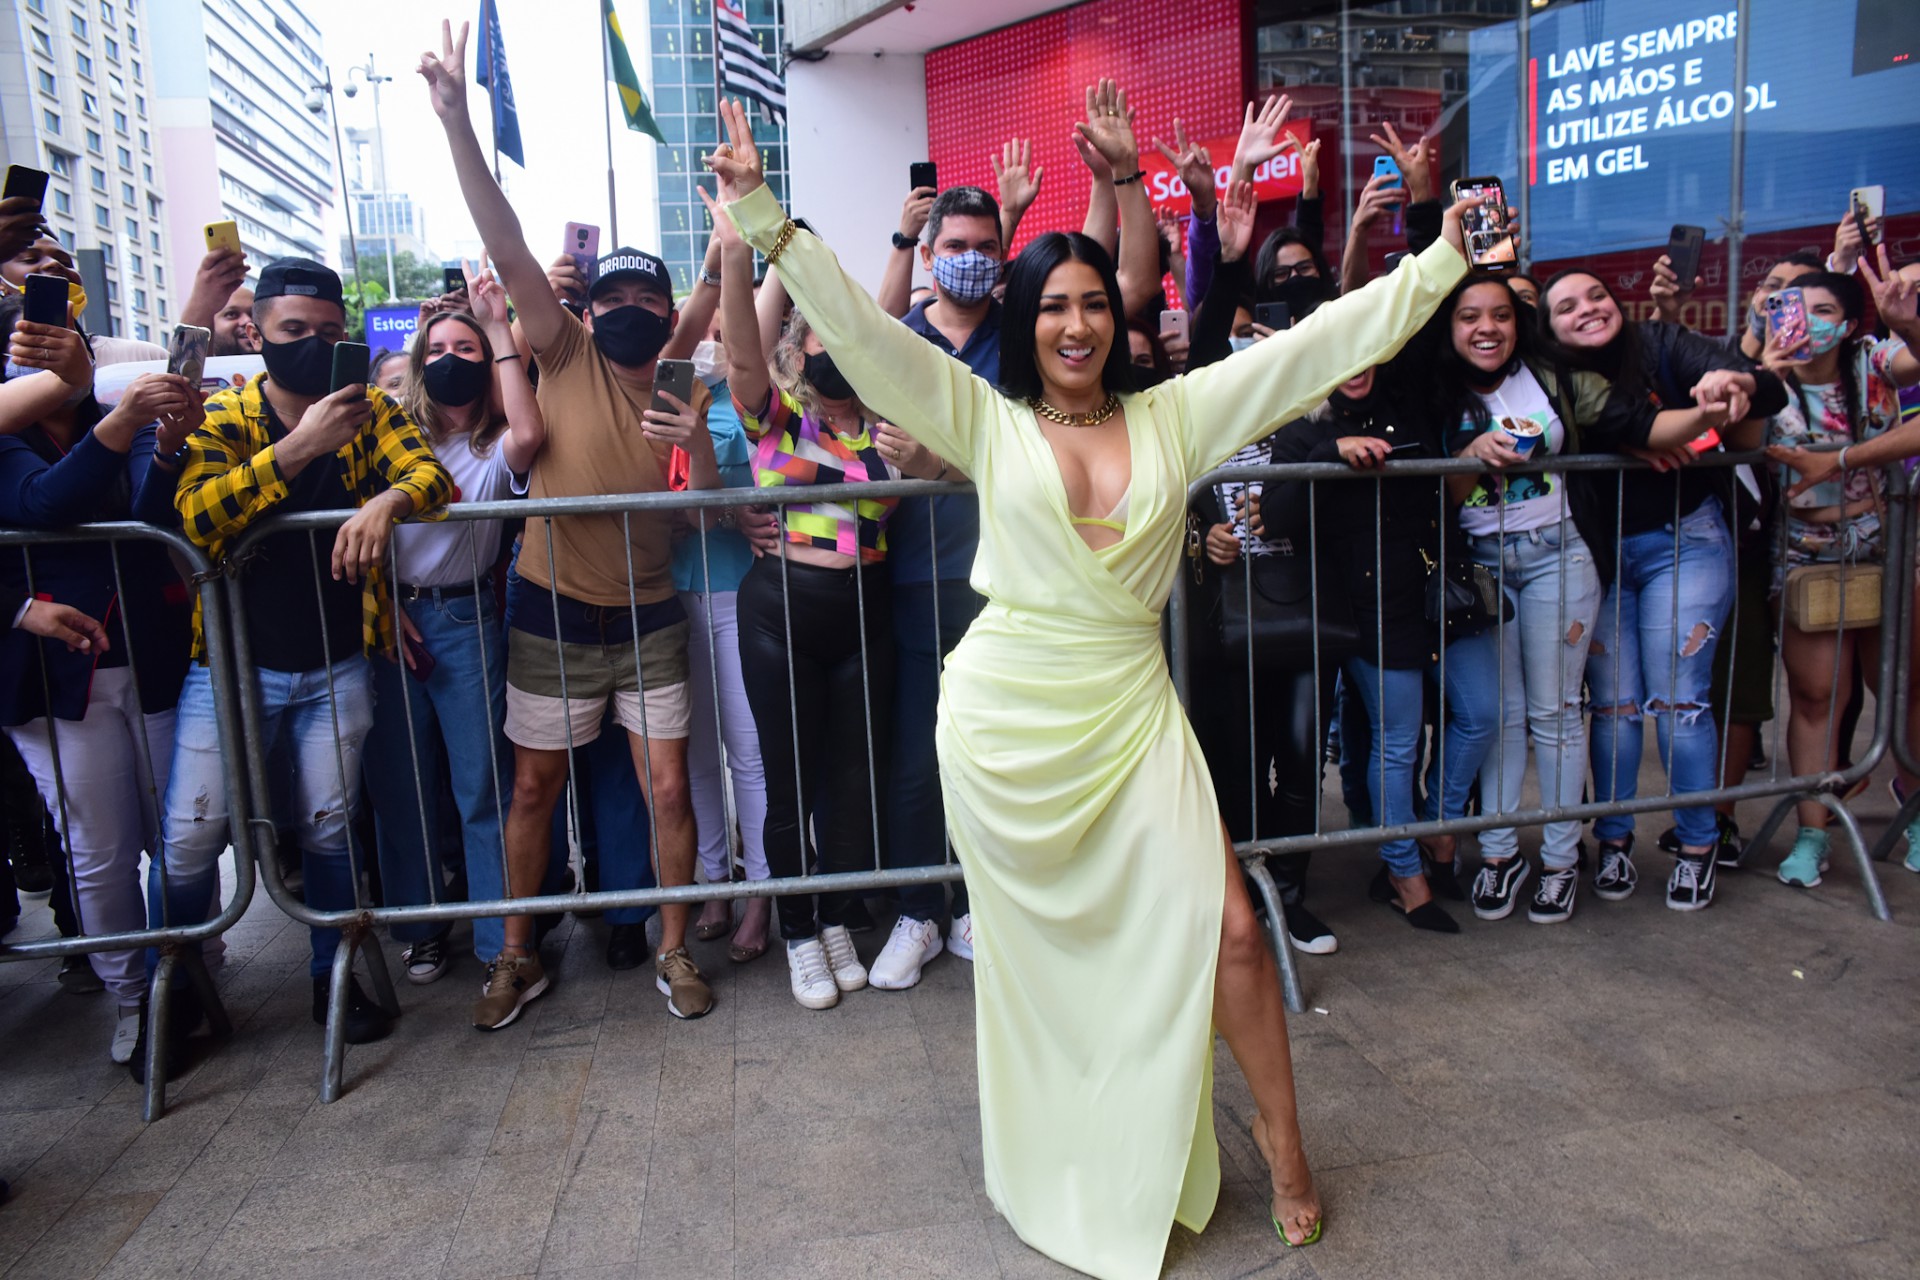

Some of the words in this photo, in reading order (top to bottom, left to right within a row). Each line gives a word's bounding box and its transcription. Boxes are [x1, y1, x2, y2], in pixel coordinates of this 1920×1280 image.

[1547, 40, 1615, 79] LAVE
[1620, 11, 1737, 62] SEMPRE
[1546, 84, 1583, 114] AS
[1589, 63, 1676, 105] MÃOS
[1684, 57, 1703, 86] E
[1546, 107, 1649, 149] UTILIZE
[1547, 154, 1589, 185] EM
[1595, 144, 1650, 176] GEL
[598, 255, 658, 278] BRADDOCK
